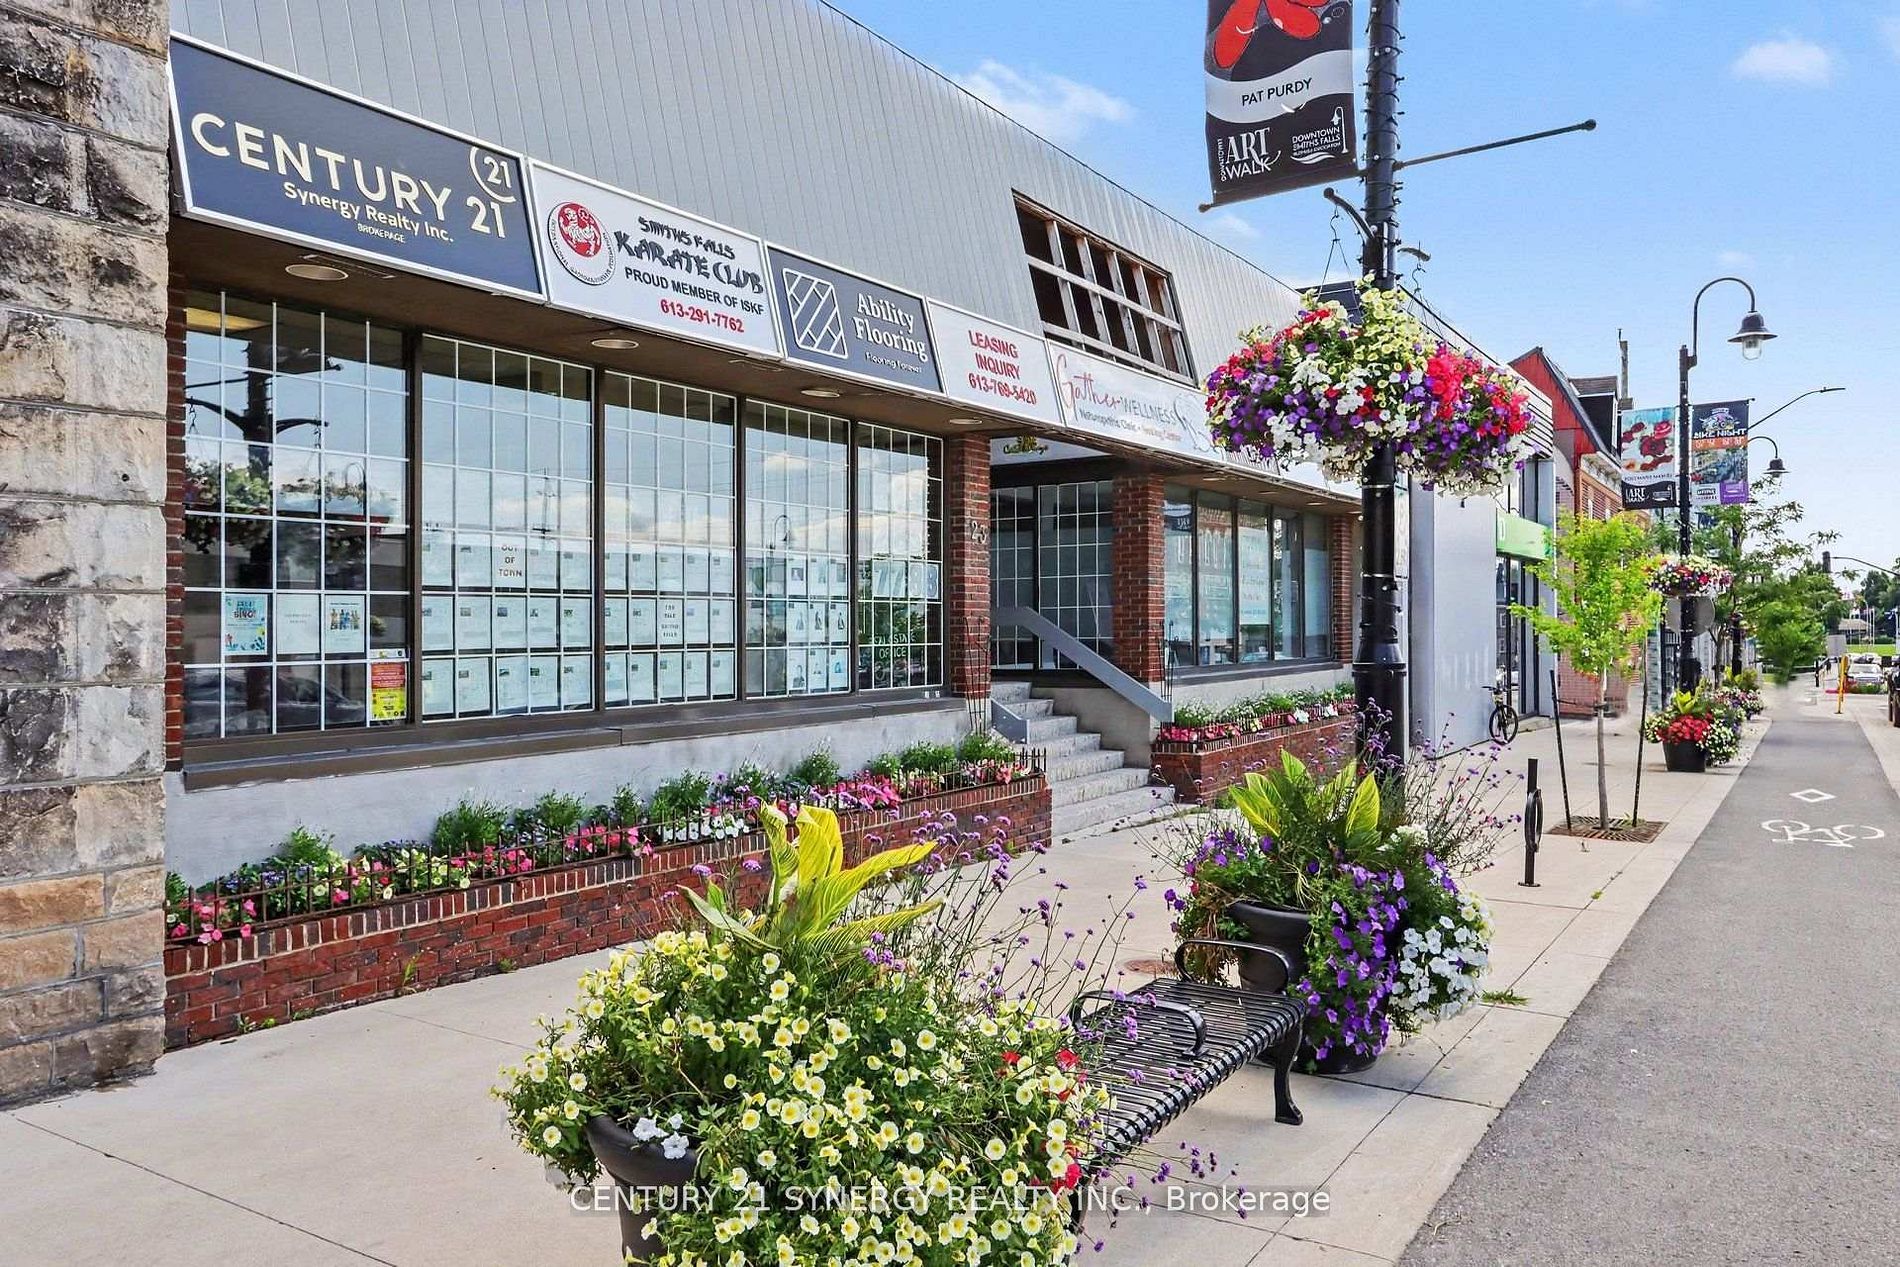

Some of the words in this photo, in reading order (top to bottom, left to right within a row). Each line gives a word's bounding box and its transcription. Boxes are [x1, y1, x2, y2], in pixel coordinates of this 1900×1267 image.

[1242, 91, 1263, 106] PAT
[1268, 78, 1312, 100] PURDY
[1226, 127, 1271, 163] ART
[1292, 126, 1340, 144] DOWNTOWN
[1293, 139, 1319, 151] SMITHS
[1320, 133, 1341, 146] FALLS
[191, 113, 452, 221] CENTURY
[466, 196, 506, 238] 21
[484, 157, 513, 188] 21
[1225, 156, 1272, 180] WALK
[285, 182, 360, 220] Synergy
[366, 205, 419, 236] Realty
[424, 222, 454, 243] Inc.
[357, 223, 405, 244] BROKERAGE
[638, 216, 692, 246] SMITHS
[694, 235, 735, 260] FALLS
[614, 230, 710, 279] KARATE
[712, 261, 763, 294] CLUB
[625, 267, 669, 290] PROUD
[672, 279, 721, 304] MEMBER
[724, 295, 739, 307] OF
[741, 298, 765, 316] ISKF
[660, 299, 745, 333] 613-291-7762
[857, 293, 914, 334] Ability
[853, 317, 928, 363] Flooring
[968, 330, 1019, 359] LEASING
[975, 352, 1020, 380] INQUIRY
[1121, 396, 1177, 426] WELLNESS
[1717, 428, 1747, 437] NIGHT
